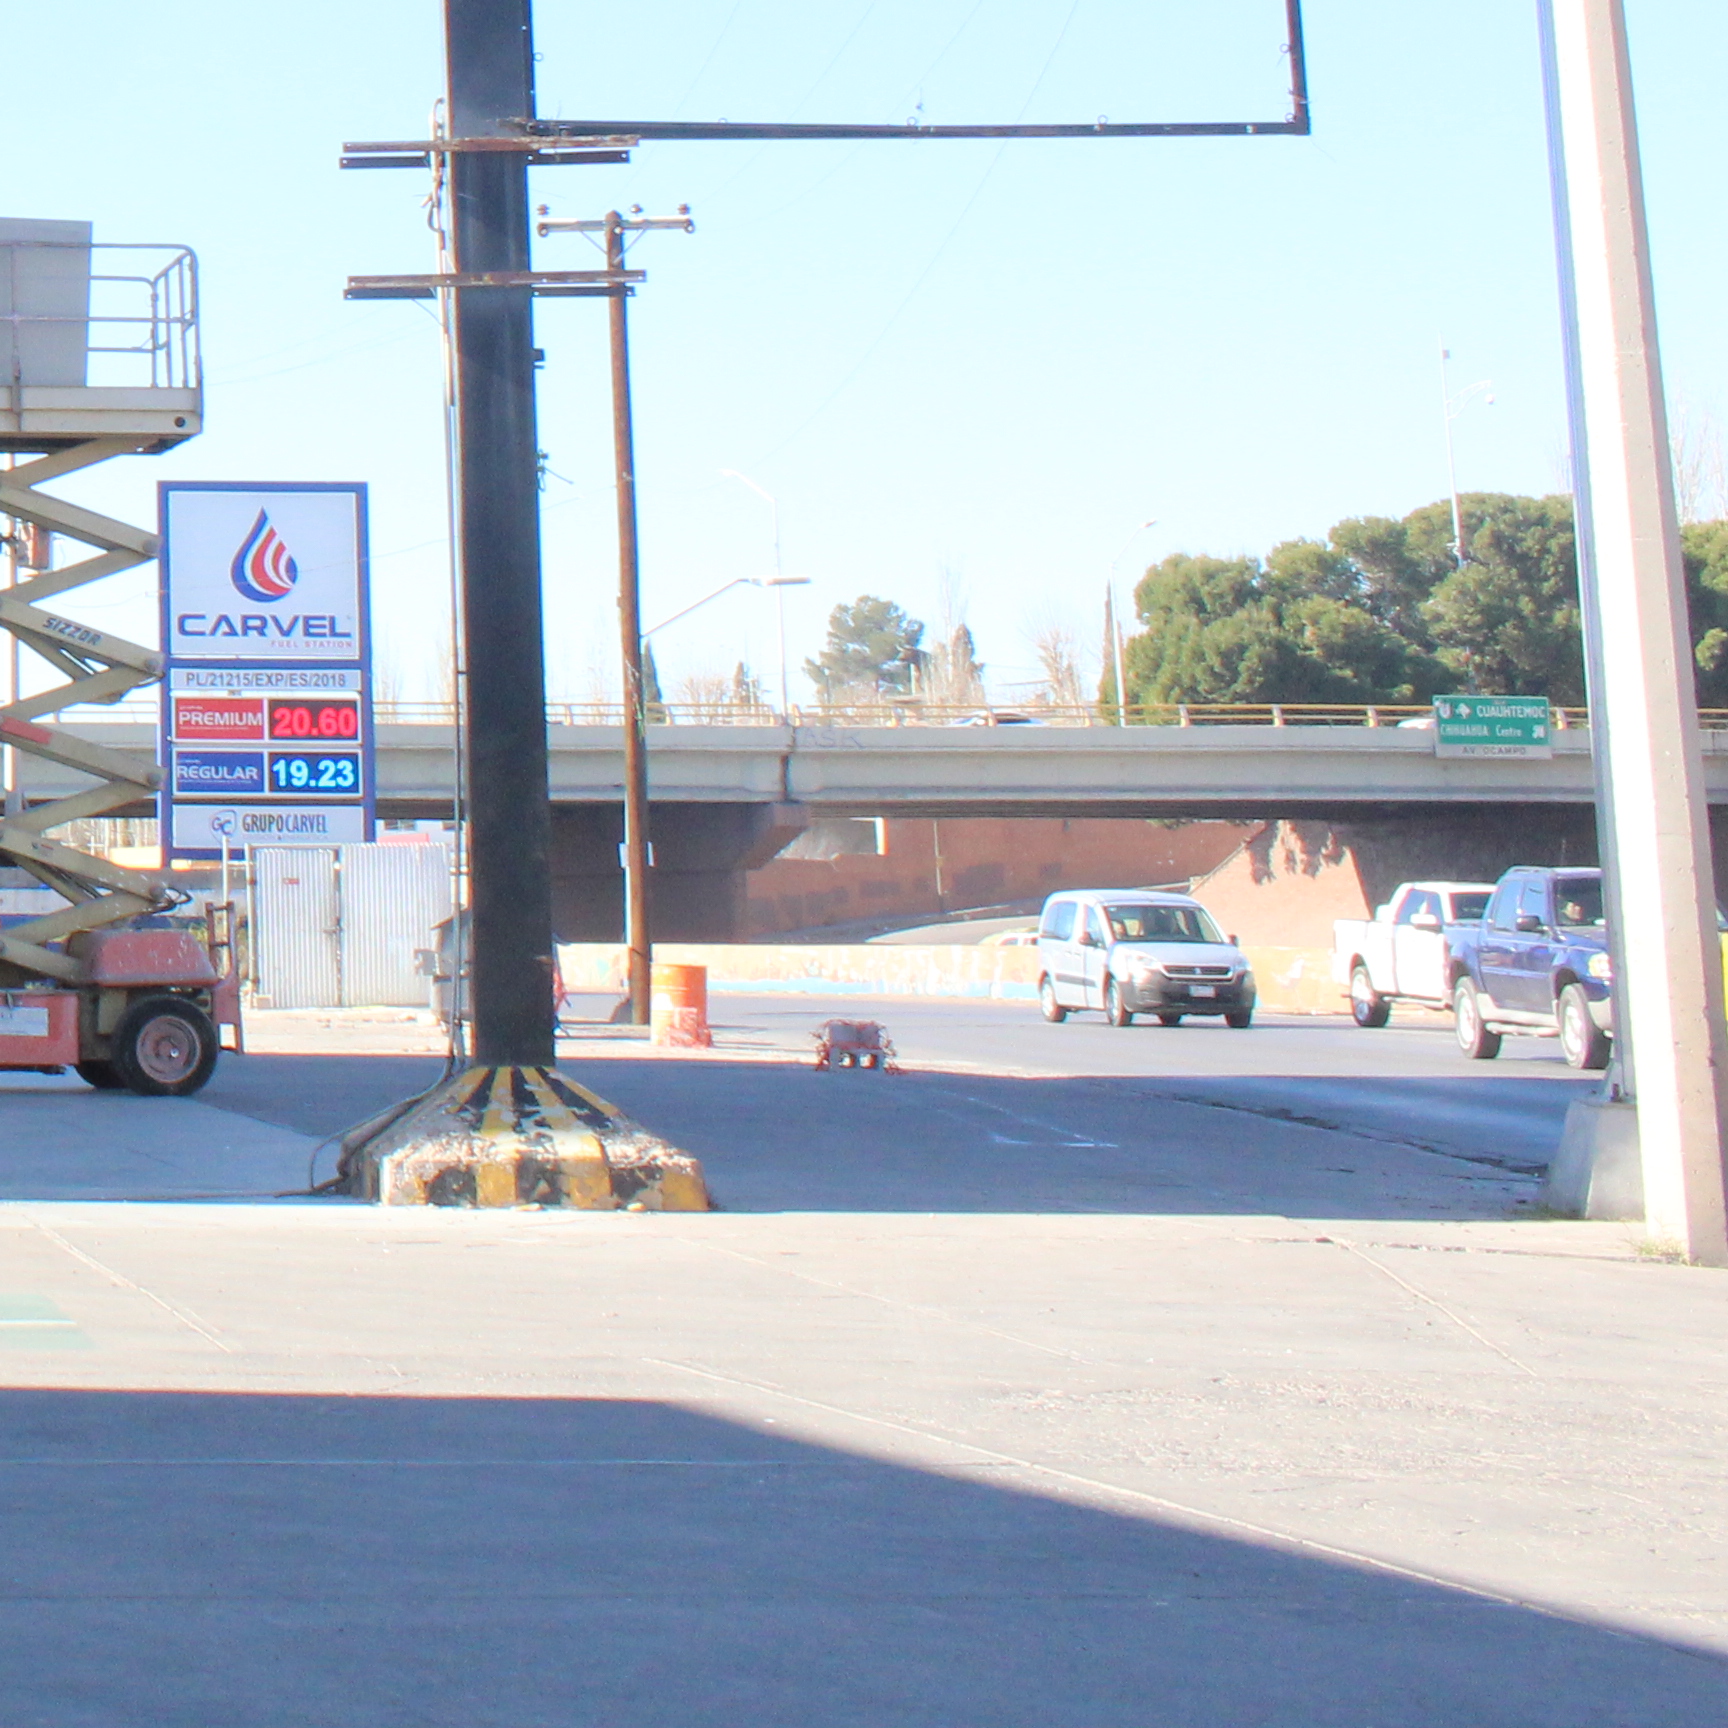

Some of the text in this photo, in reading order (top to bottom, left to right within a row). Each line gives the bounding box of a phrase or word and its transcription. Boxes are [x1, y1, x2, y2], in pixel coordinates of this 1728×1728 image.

[177, 613, 352, 638] CARVEL
[270, 640, 353, 649] FUEL STATION
[185, 672, 347, 687] PL/21215/EXP/ES/2018
[178, 707, 358, 737] PREMIUM 20.60
[1495, 724, 1523, 737] Centro
[176, 758, 356, 788] REGULAR 19.23
